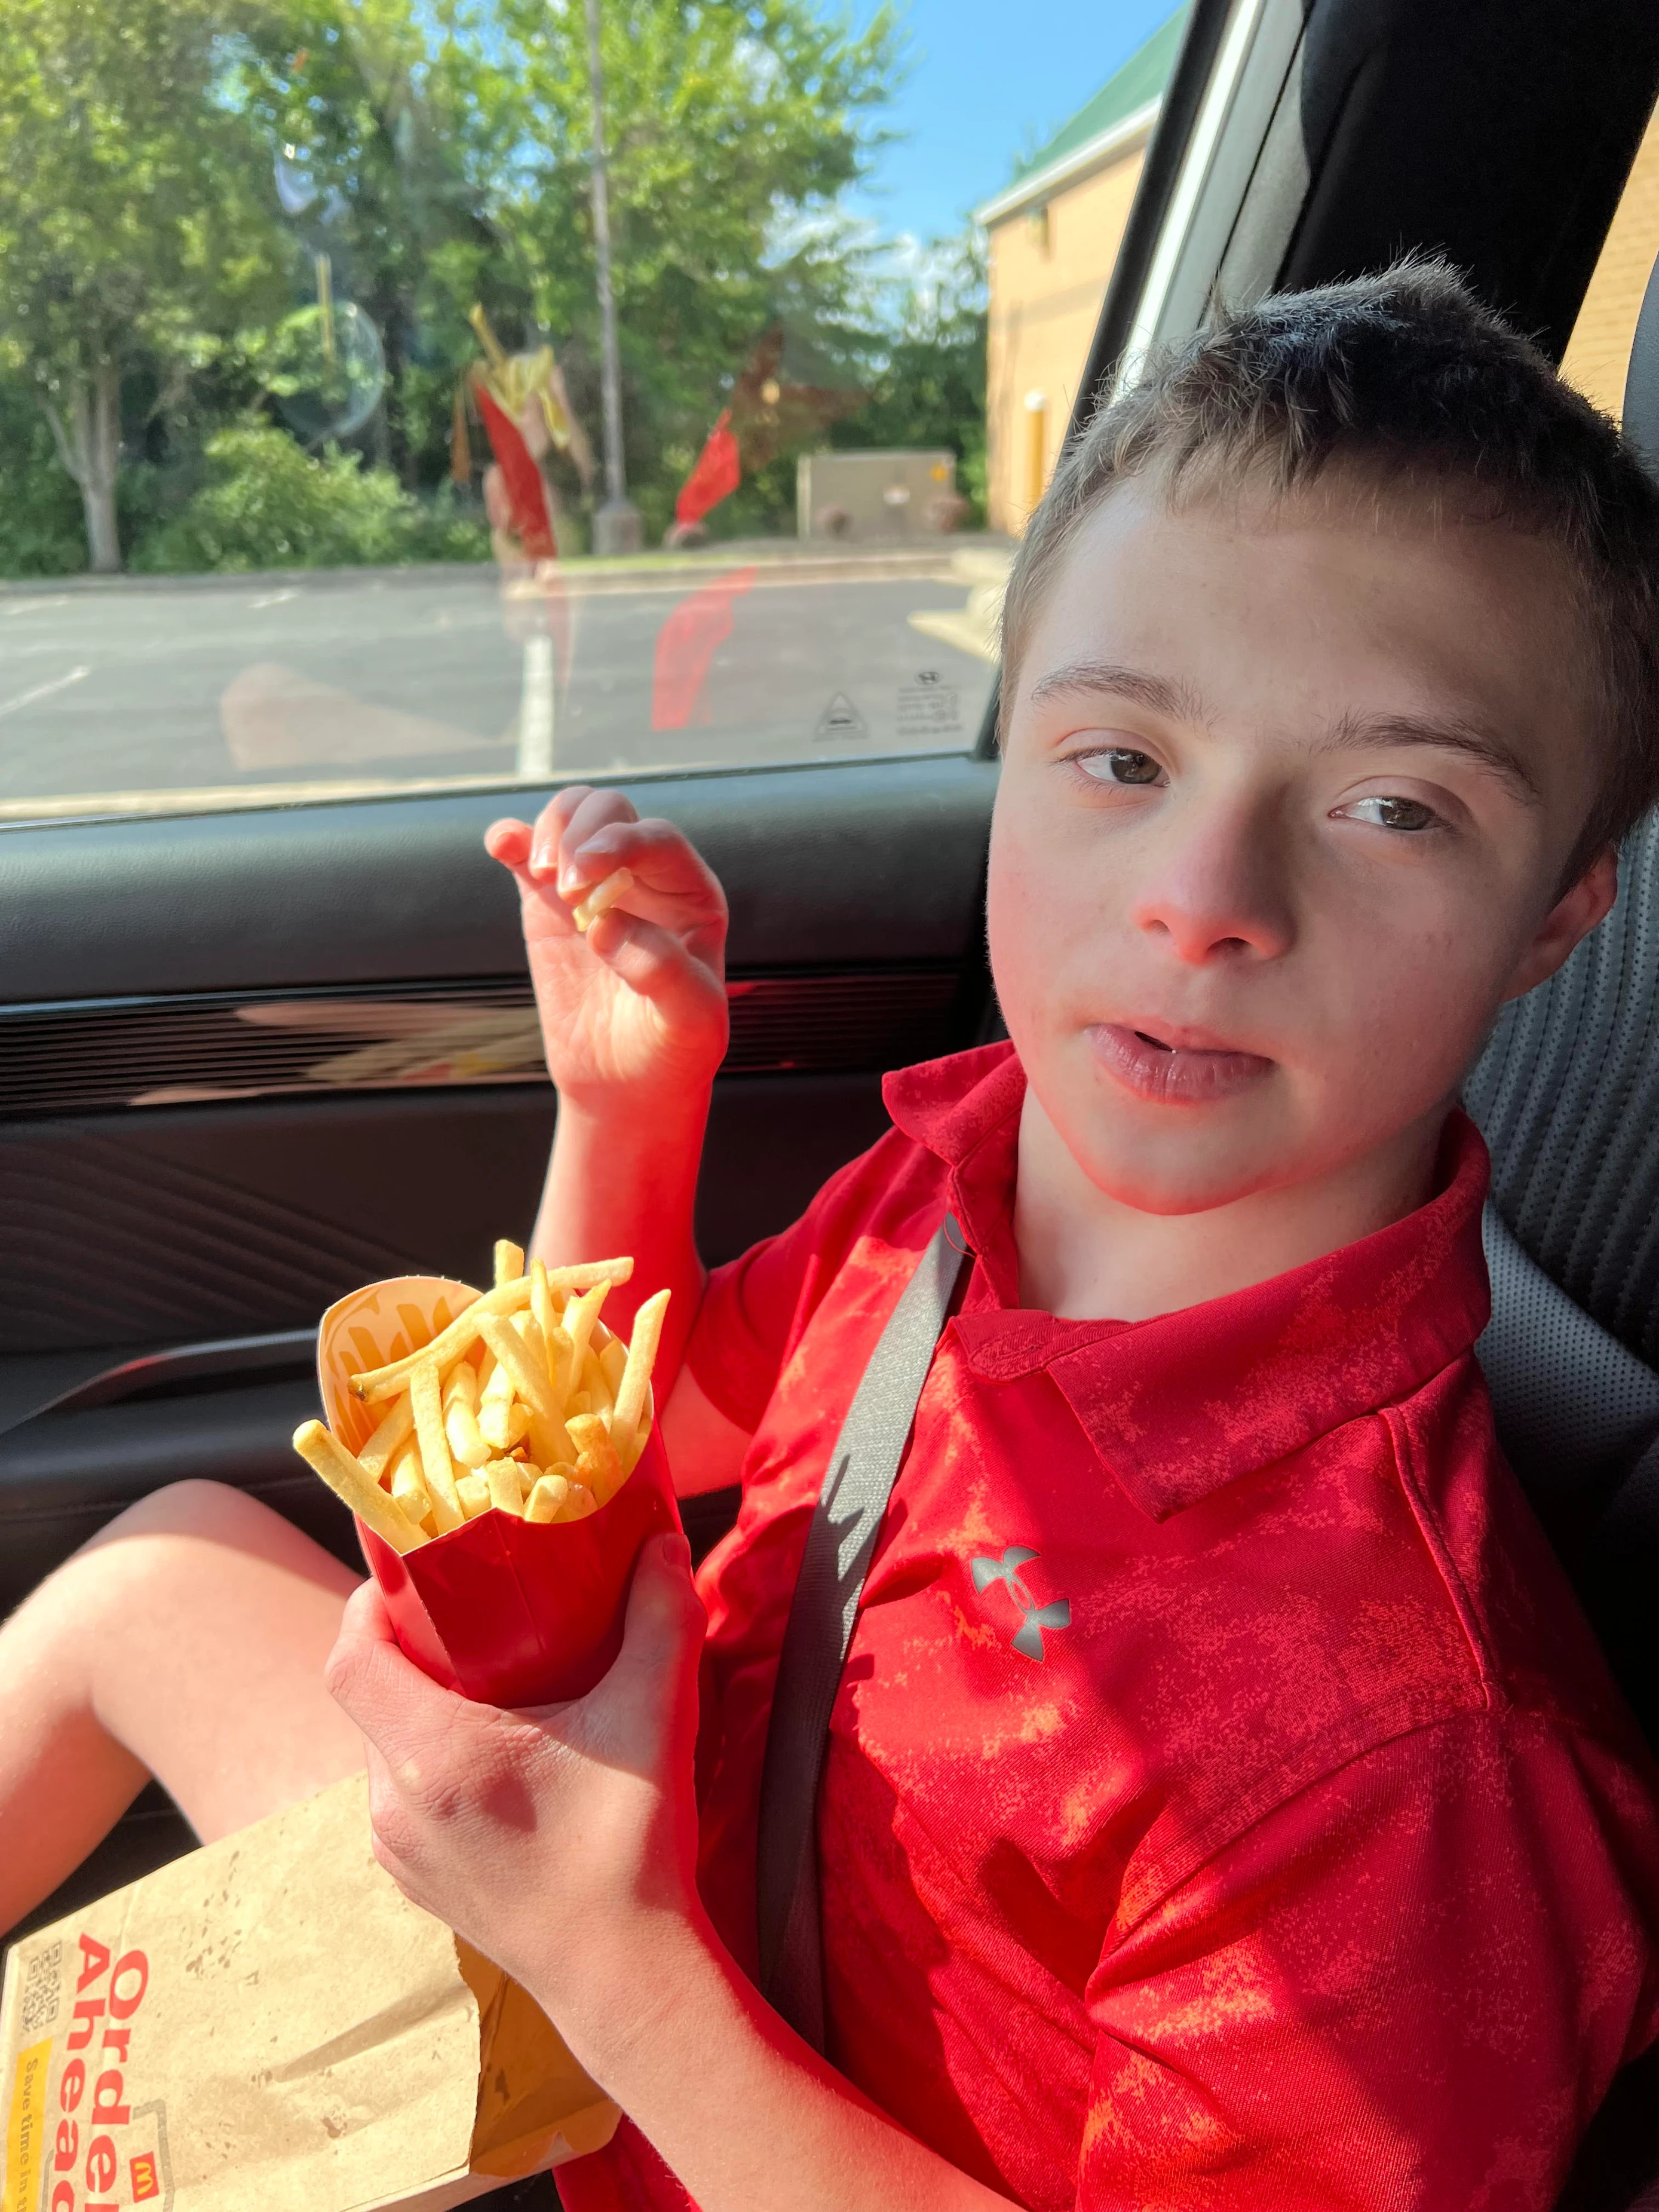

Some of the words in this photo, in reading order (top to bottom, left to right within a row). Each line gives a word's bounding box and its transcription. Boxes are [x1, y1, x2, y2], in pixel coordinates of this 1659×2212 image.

[22, 2057, 38, 2110] Save
[85, 1950, 149, 2212] Orde
[20, 2114, 33, 2165] time
[19, 2168, 31, 2193] in
